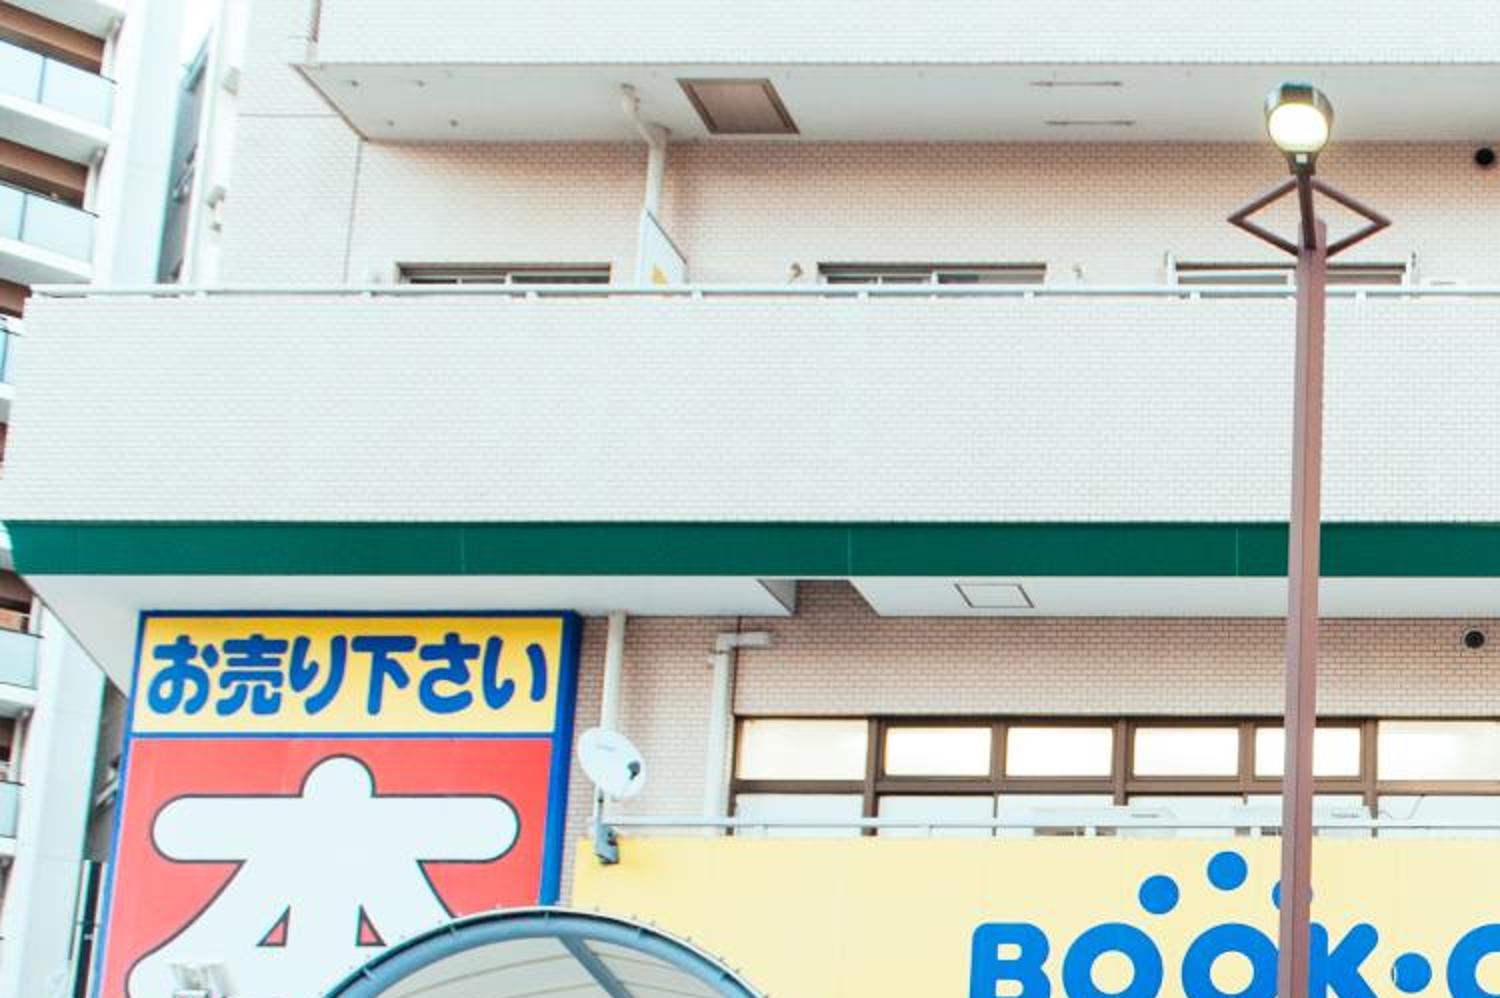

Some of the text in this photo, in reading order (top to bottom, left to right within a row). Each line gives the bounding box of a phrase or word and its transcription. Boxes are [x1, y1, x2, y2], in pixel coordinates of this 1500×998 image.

[147, 633, 547, 717] お売り下さい
